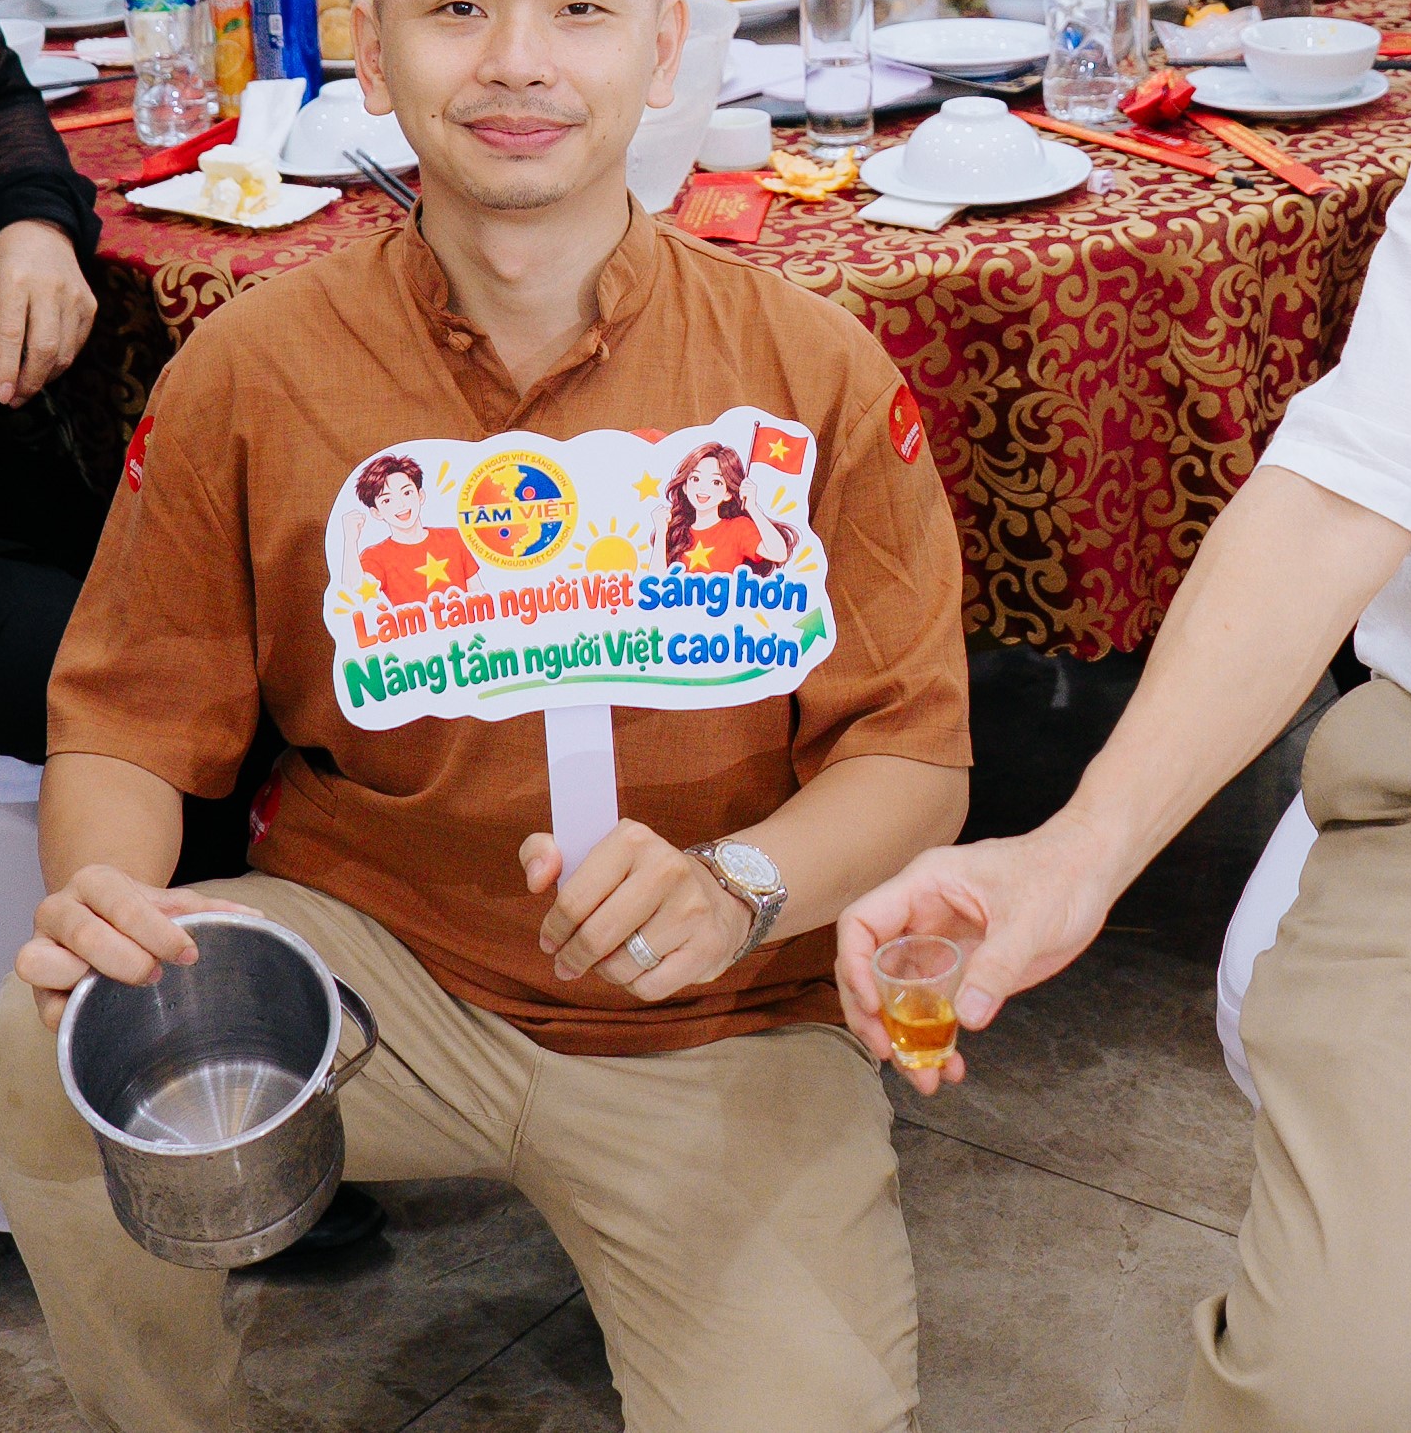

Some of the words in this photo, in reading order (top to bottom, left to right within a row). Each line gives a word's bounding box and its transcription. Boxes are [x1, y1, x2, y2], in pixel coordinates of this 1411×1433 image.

[459, 505, 512, 524] TÂM
[518, 499, 575, 520] VIỆT
[352, 602, 427, 648] Làm
[429, 589, 495, 630] tâm
[499, 575, 579, 625] người
[581, 573, 634, 615] Việt
[638, 566, 730, 617] sáng
[736, 568, 808, 613] hơn
[342, 652, 447, 708] Nâng
[447, 632, 519, 687] tầm
[523, 631, 601, 679] người
[603, 625, 663, 672] Việt
[667, 632, 730, 666] cao
[734, 623, 799, 668] hơn
